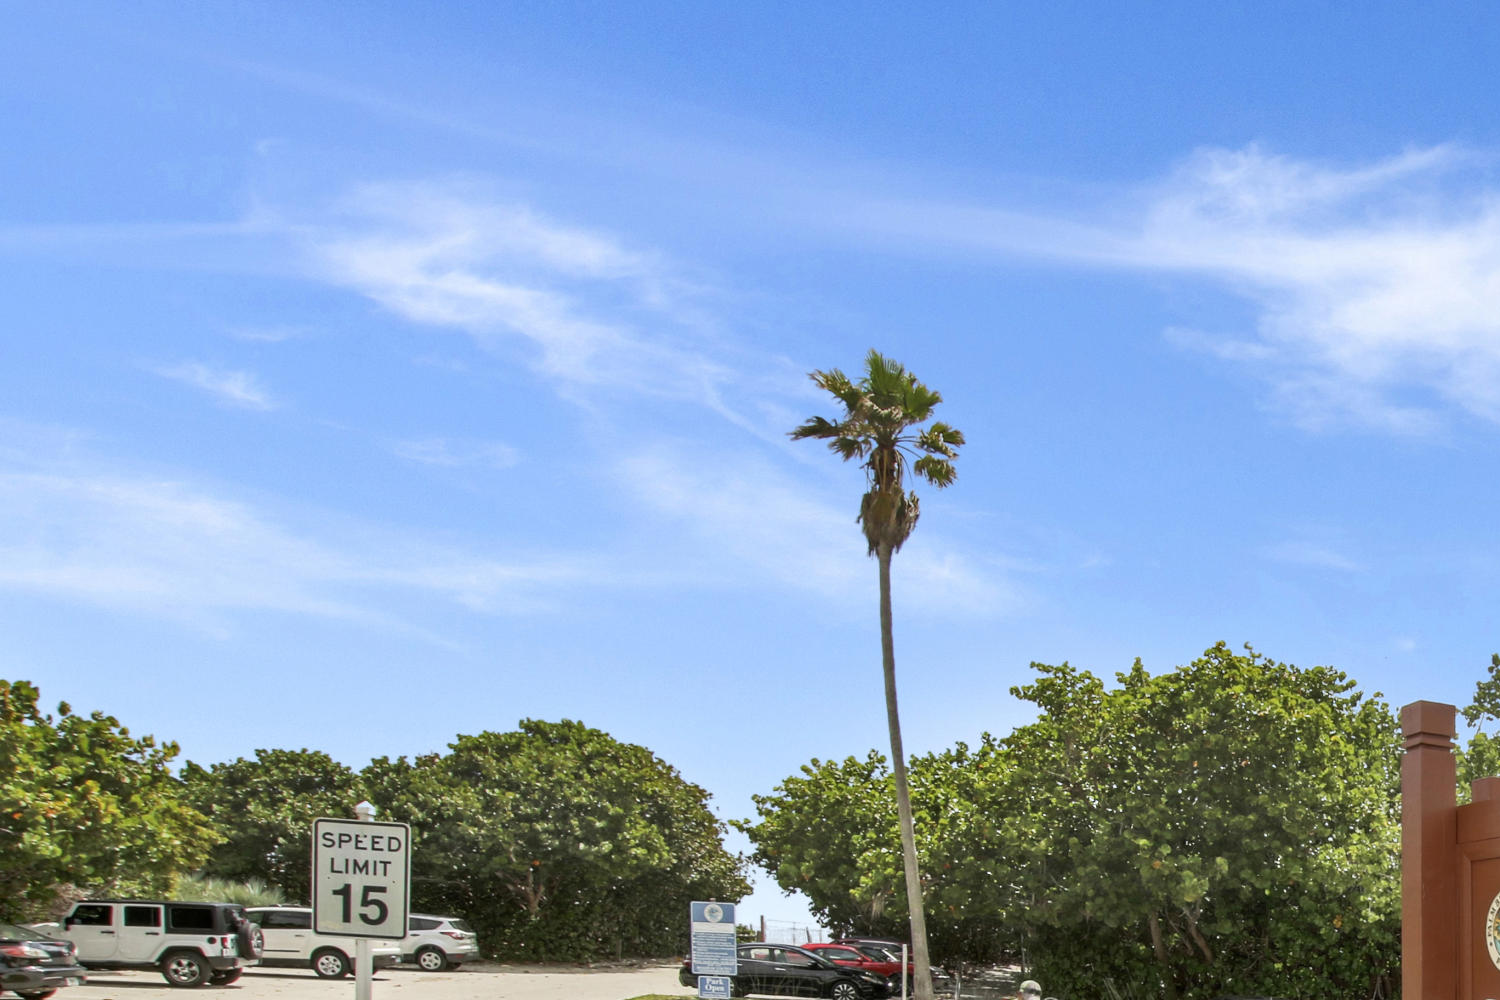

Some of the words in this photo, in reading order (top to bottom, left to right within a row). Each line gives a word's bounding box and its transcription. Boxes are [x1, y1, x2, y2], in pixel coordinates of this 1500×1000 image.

[321, 832, 402, 852] SPEED
[330, 857, 392, 877] LIMIT
[332, 883, 389, 926] 15
[1487, 907, 1496, 937] PALM
